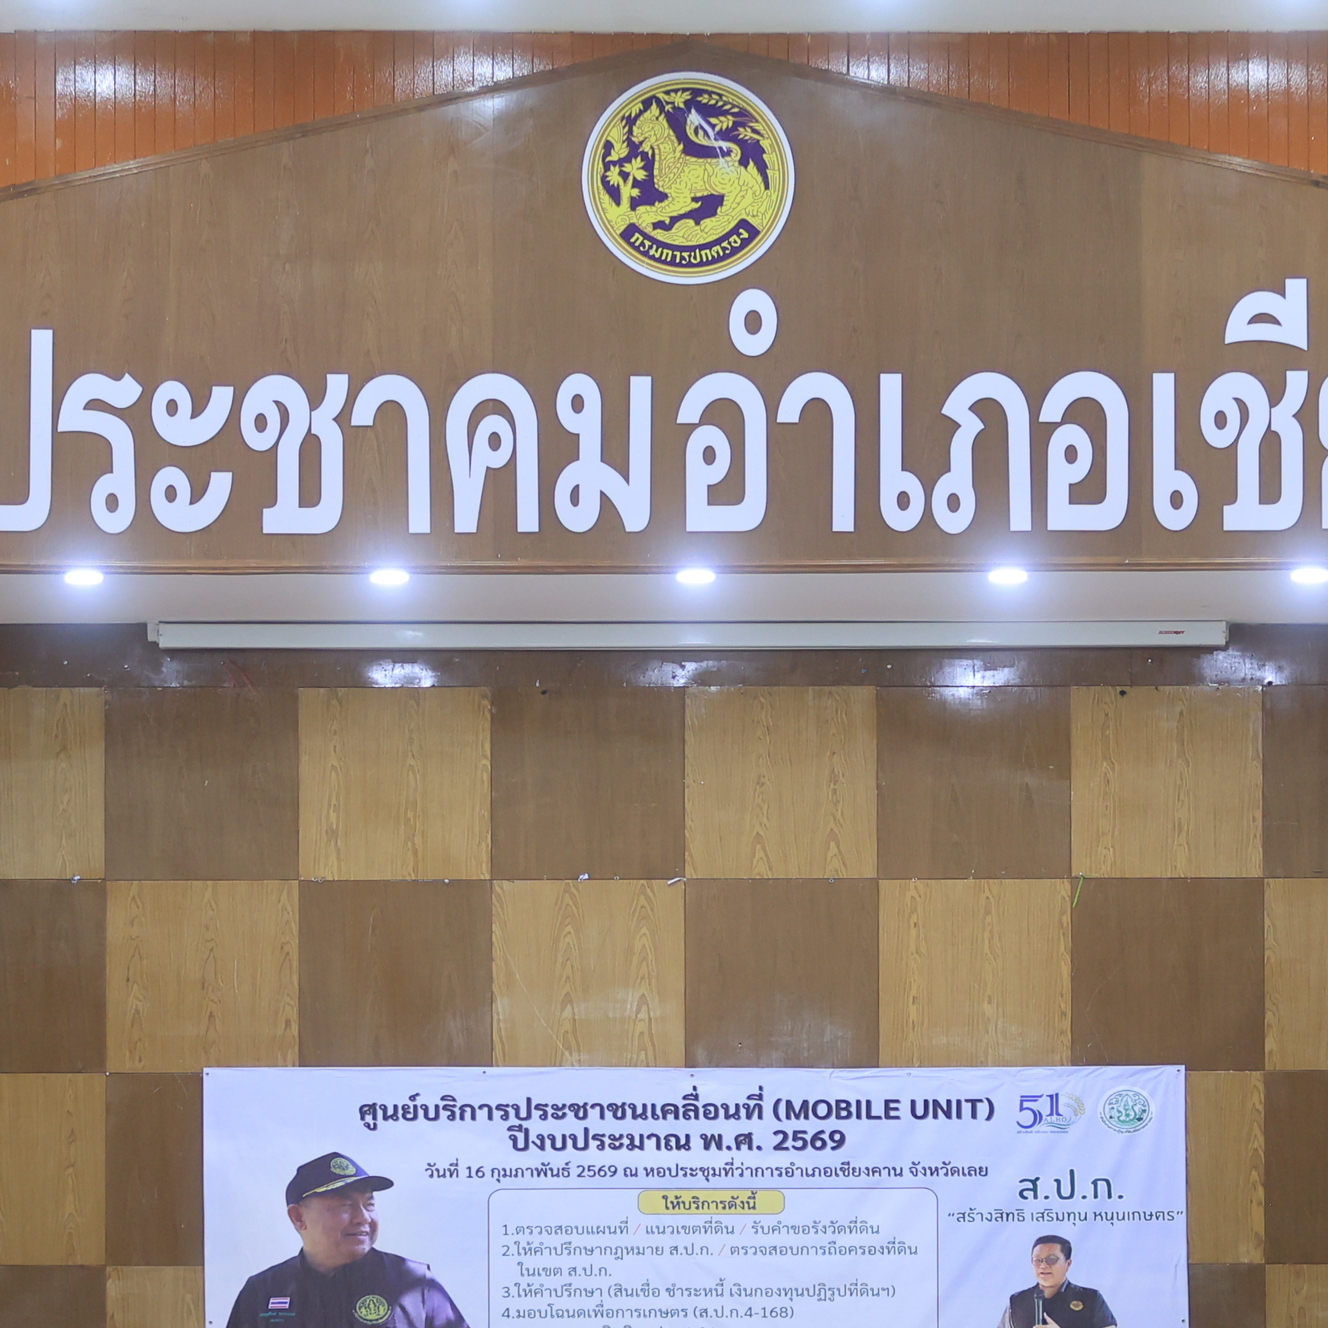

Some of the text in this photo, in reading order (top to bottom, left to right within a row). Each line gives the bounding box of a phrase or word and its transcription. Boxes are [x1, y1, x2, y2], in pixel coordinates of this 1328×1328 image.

[629, 227, 751, 265] กรมการปกครอง
[358, 1085, 996, 1131] ศูนย์บริการประชาชนเคลื่อนที่ (MOBILE UNIT)
[506, 1124, 847, 1152] ปีงบประมาณ พ.ศ. 2569
[424, 1157, 989, 1184] วันที่ 16 กุมภาพันธ์ 2569 ณ หอประชุมที่ว่าการอำเภอเชียงคาน จังหวัดเลย
[1017, 1168, 1125, 1201] ส.ป.ก.
[661, 1190, 758, 1212] ให้บริการดังนี้
[502, 1215, 629, 1236] 1.ตรวจสอบแผนที่
[645, 1216, 736, 1236] แนวเขตที่ดิน
[751, 1215, 881, 1235] รับคำขอรังวัดที่ดิน
[1030, 1208, 1088, 1226] เสริมทุน
[501, 1241, 665, 1260] 2.ให้คำปรึกษากฎหมาย
[668, 1243, 715, 1256] ส.ป.ก.
[729, 1236, 919, 1256] ตรวจสอบการถือครองที่ดิน
[517, 1261, 613, 1277] ในเขต ส.ป.ก.
[501, 1282, 603, 1298] 3.ให้คำปรึกษา
[607, 1279, 661, 1299] (สินเชื่อ
[665, 1278, 725, 1298] ชำระหนี้
[501, 1300, 795, 1319] 4.มอบโฉนดเพื่อการเกษตร (ส.ป.ก.4-168)
